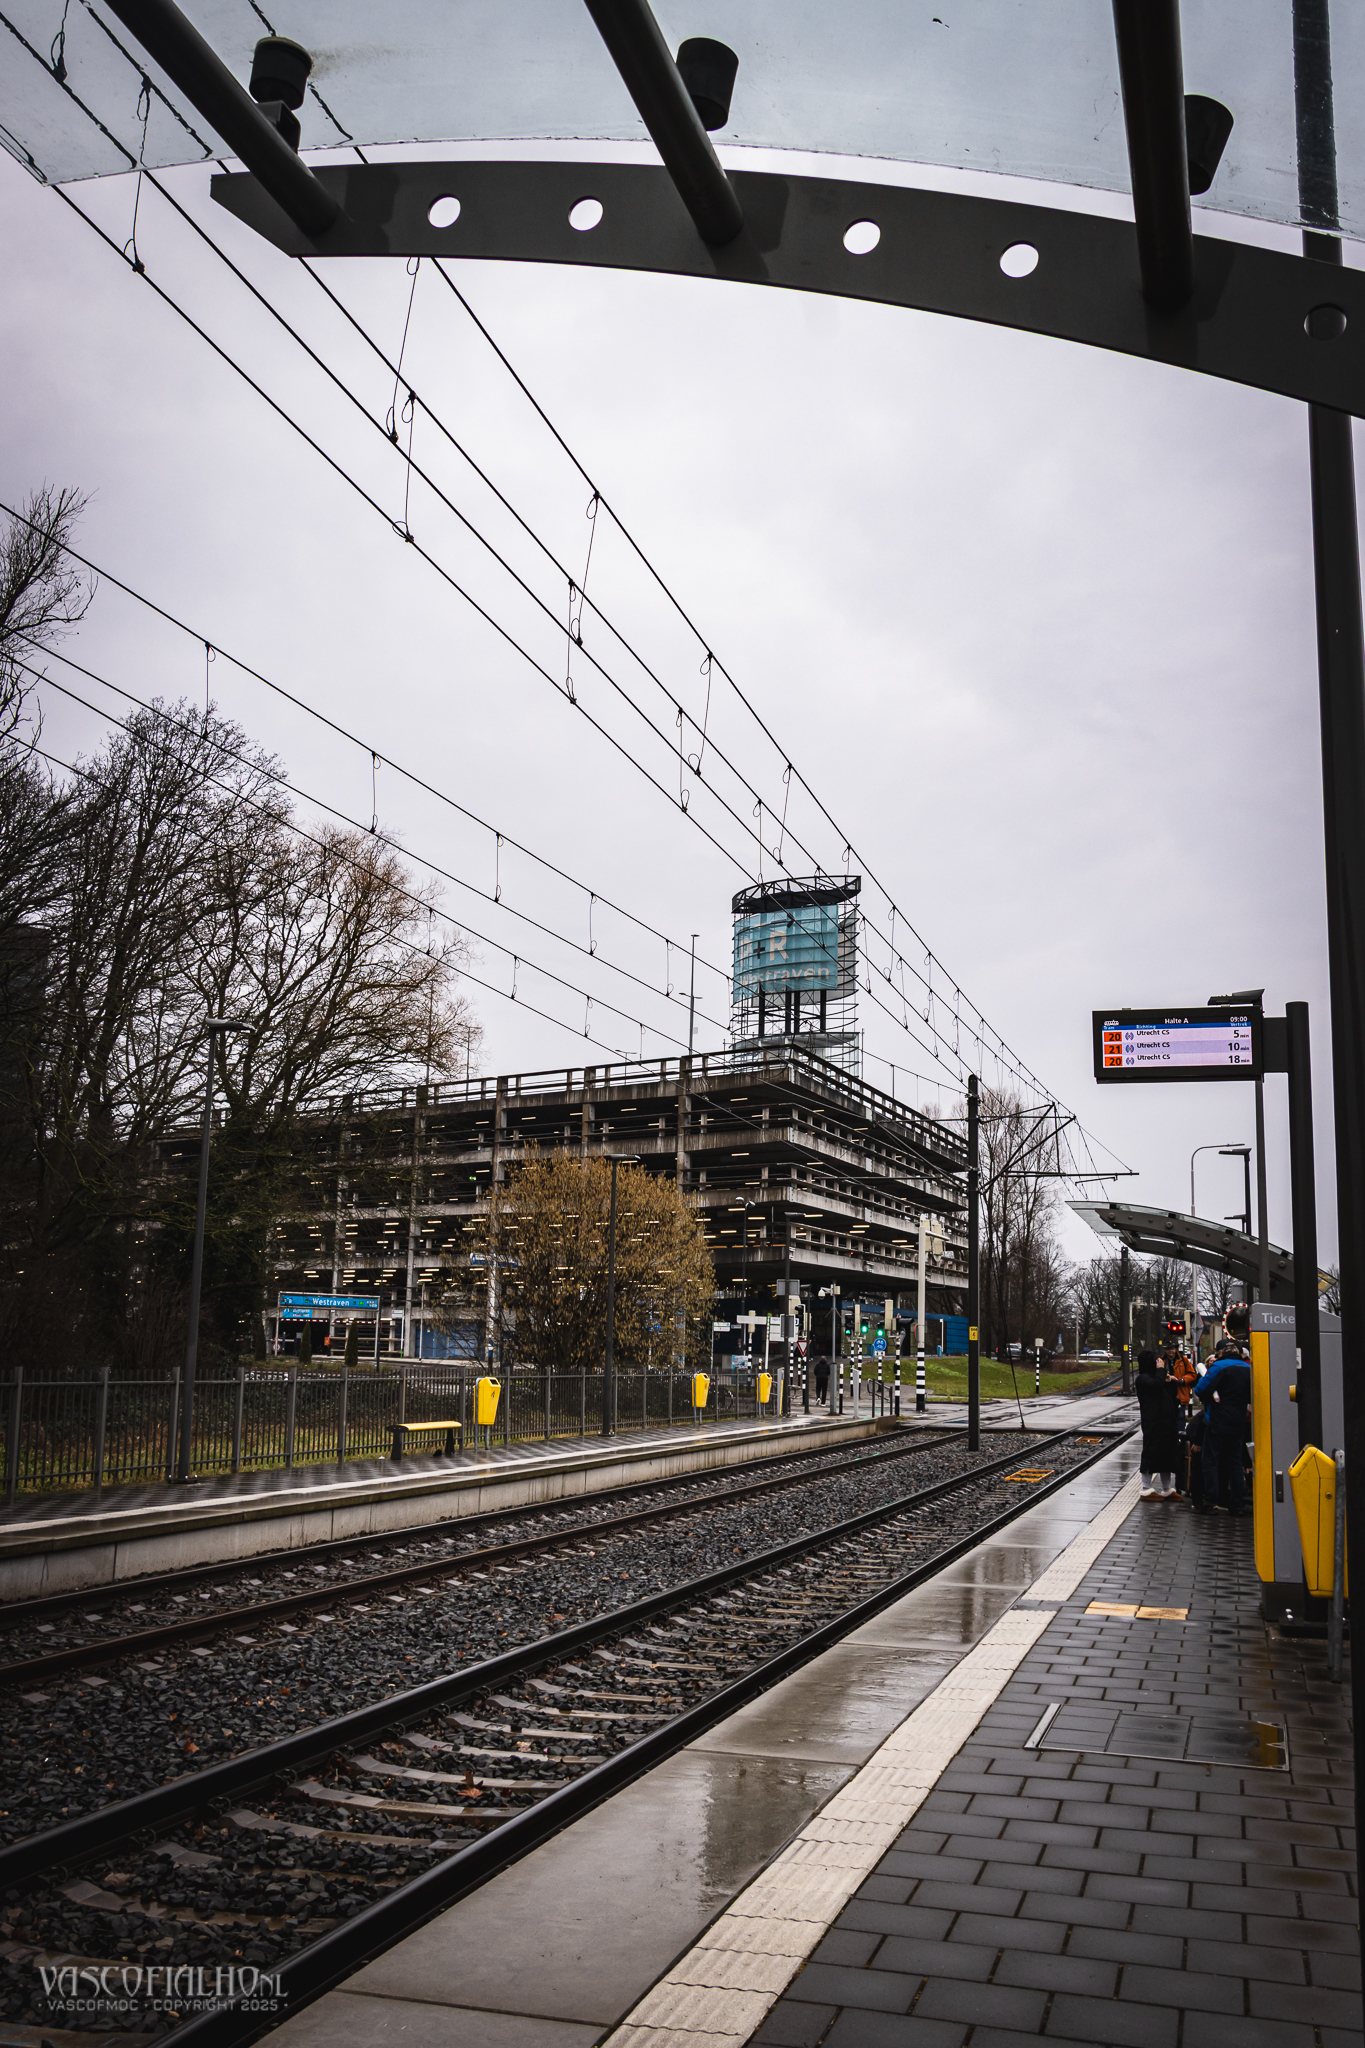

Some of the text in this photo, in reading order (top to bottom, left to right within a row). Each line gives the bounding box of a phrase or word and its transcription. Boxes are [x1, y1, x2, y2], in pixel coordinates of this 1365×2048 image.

[740, 966, 829, 987] Westraven
[1108, 1033, 1121, 1042] 20
[1233, 1029, 1240, 1038] 5
[1109, 1045, 1121, 1054] 21
[1228, 1042, 1240, 1051] 10
[1109, 1057, 1122, 1066] 20
[1228, 1055, 1240, 1064] 18
[312, 1297, 350, 1307] Westraven
